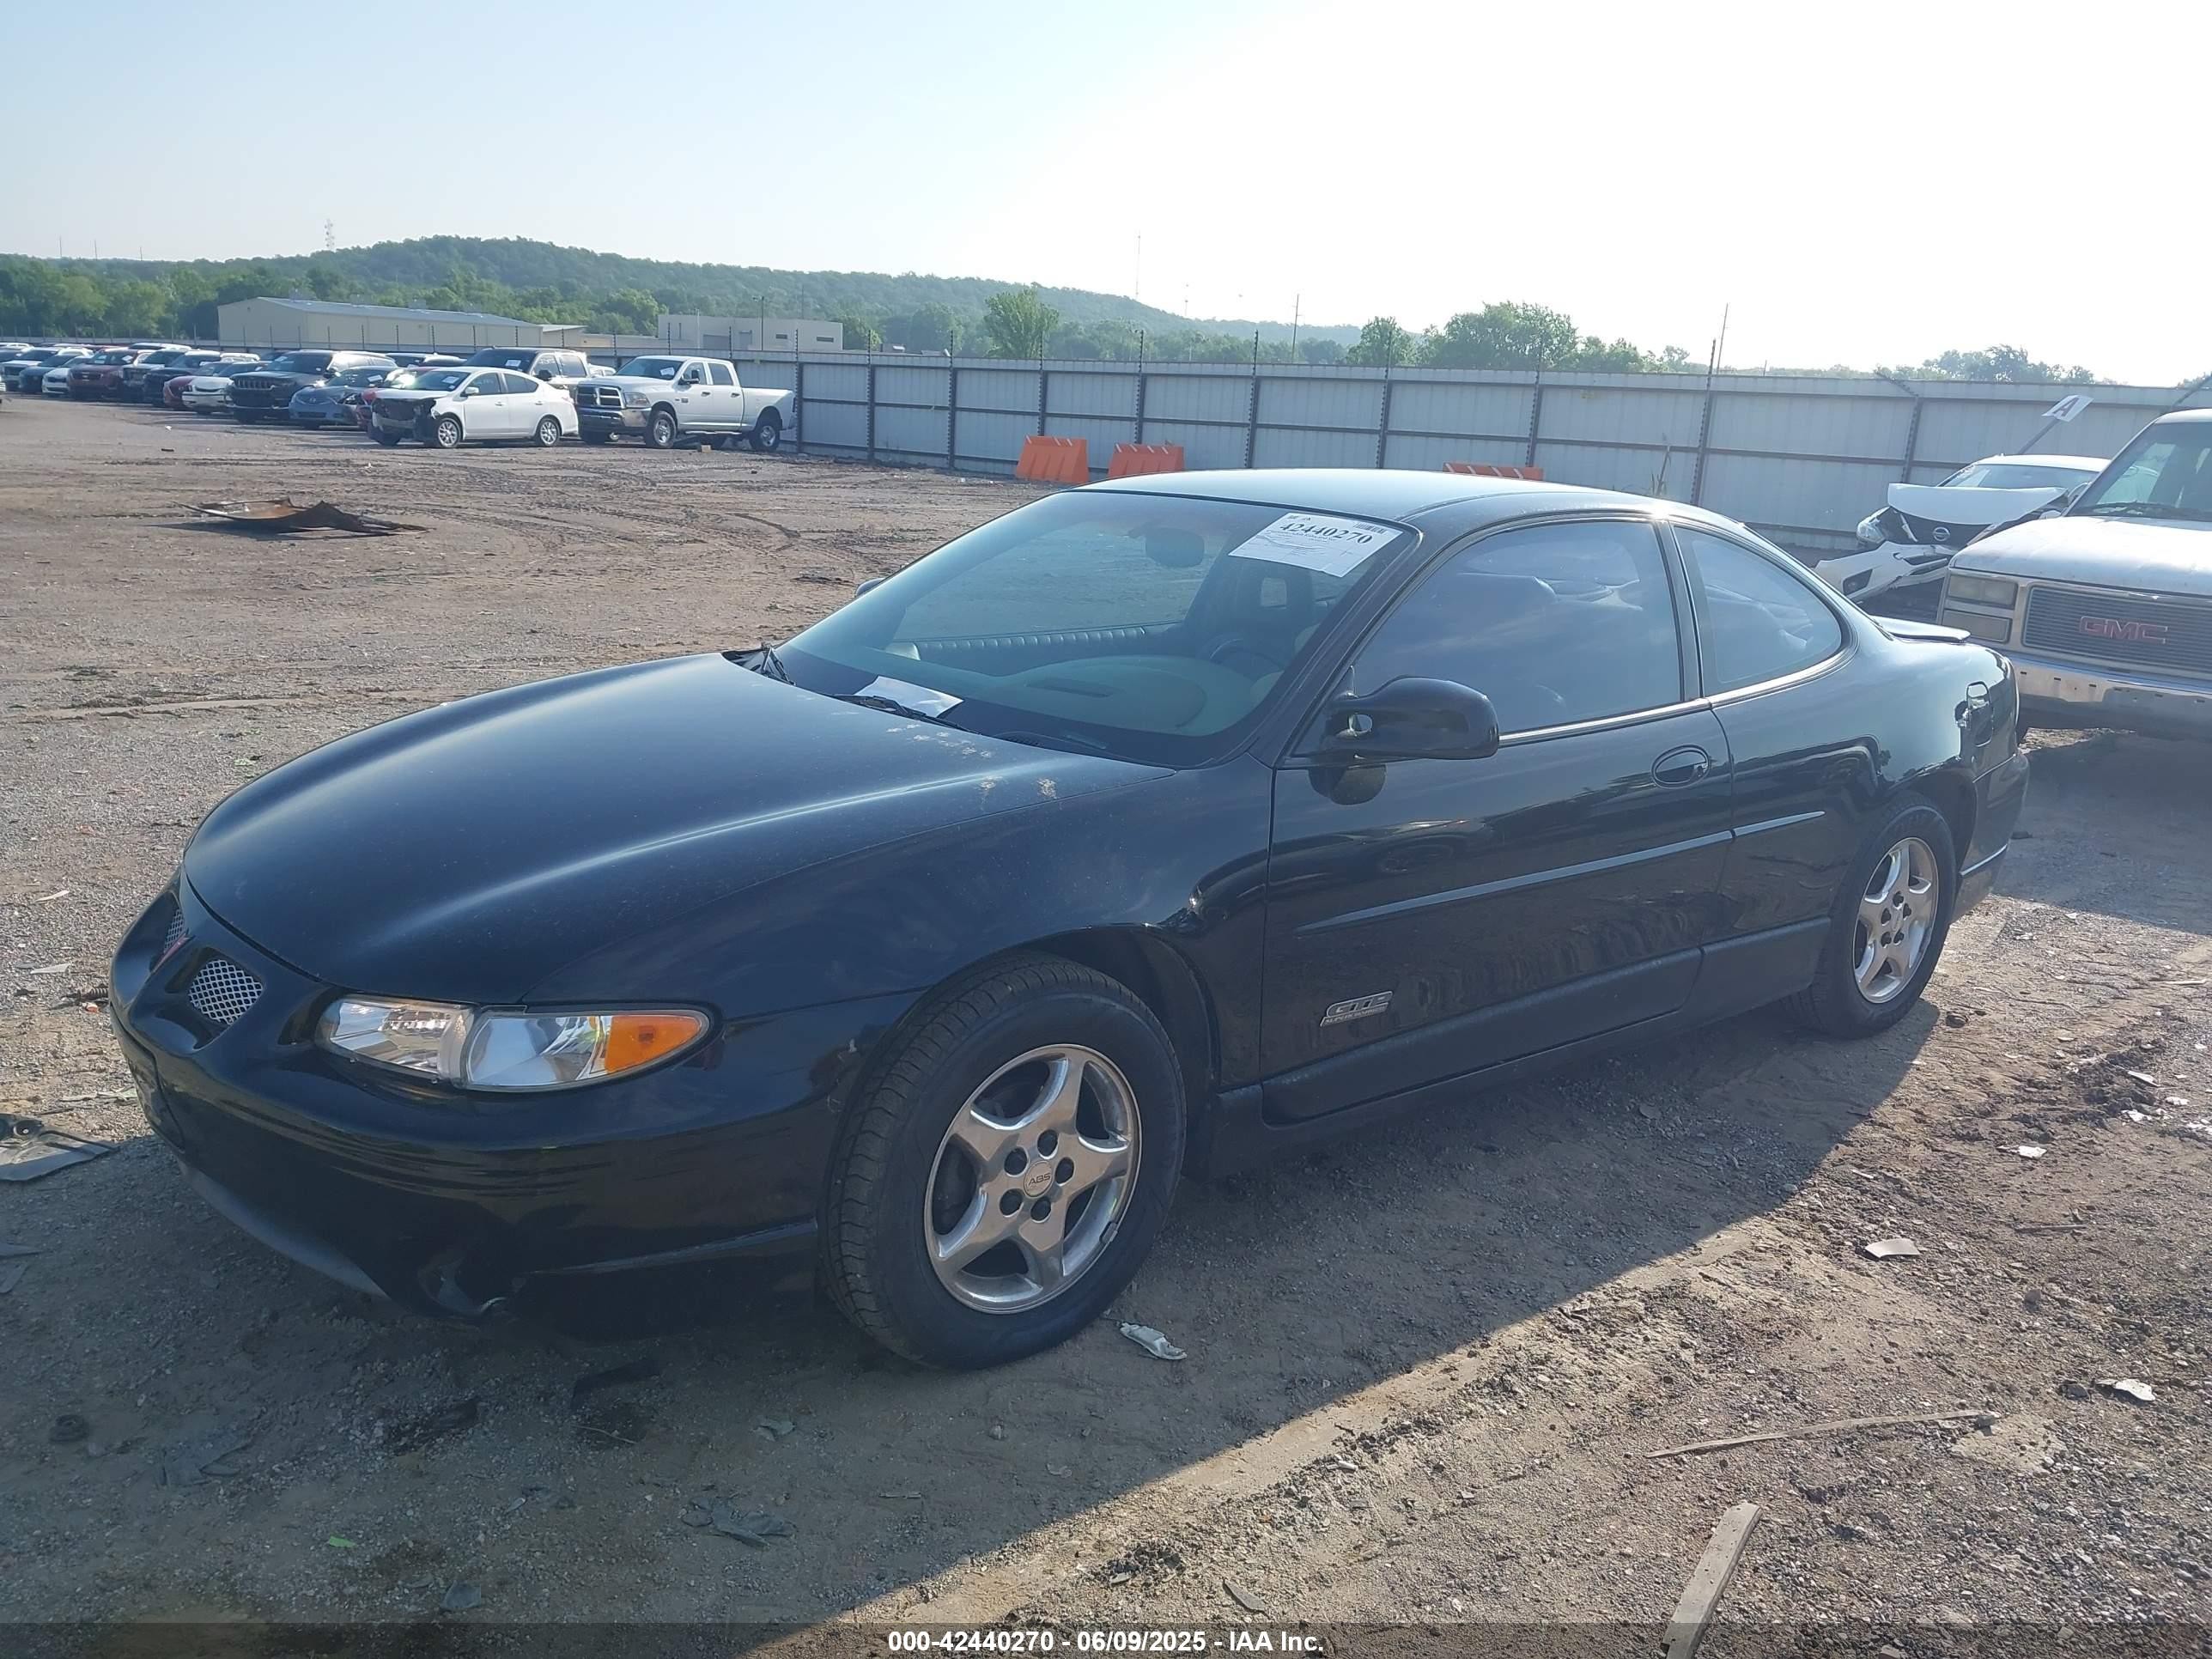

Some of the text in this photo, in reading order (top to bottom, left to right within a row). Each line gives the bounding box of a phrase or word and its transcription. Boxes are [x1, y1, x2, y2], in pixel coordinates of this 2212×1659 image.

[2052, 398, 2080, 416] A
[1280, 522, 1373, 544] 42440270
[2079, 616, 2168, 644] GMC
[1029, 1173, 1051, 1186] ABS
